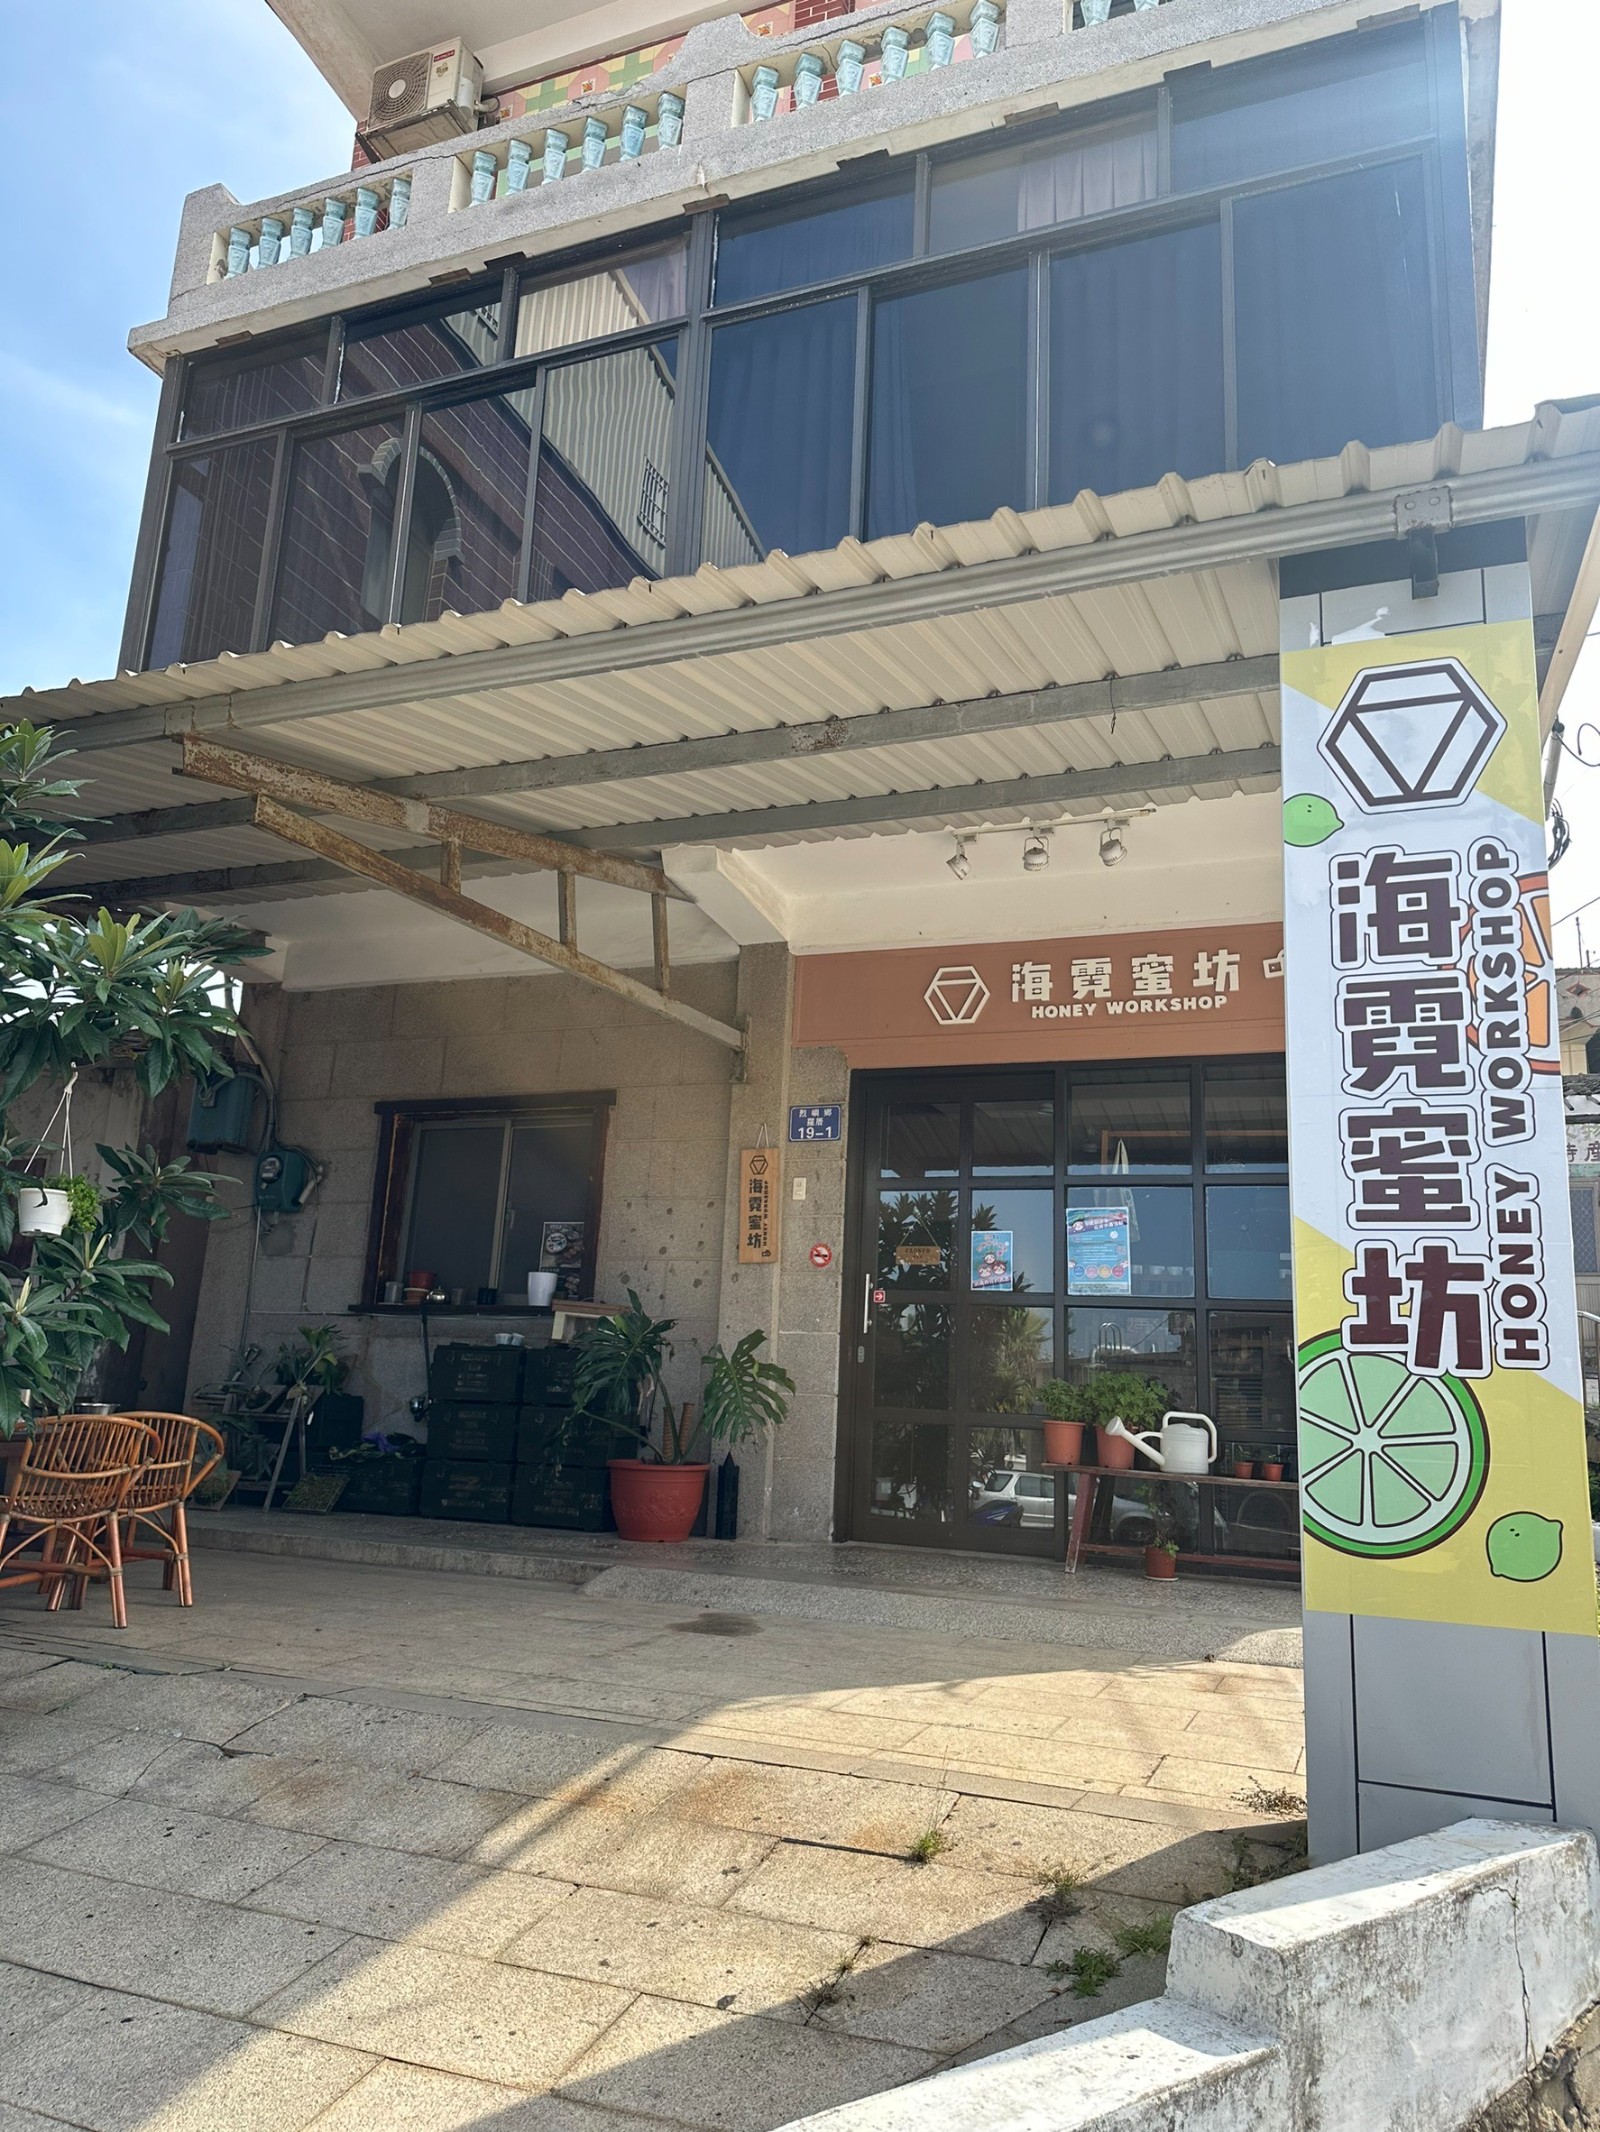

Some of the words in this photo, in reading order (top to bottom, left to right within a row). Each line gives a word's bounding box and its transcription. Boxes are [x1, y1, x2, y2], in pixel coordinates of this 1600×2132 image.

[1011, 949, 1240, 1002] 海霓蜜坊
[1031, 1003, 1097, 1019] HONEY
[1107, 995, 1228, 1015] WORKSHOP
[1476, 843, 1527, 1139] WORKSHOP
[798, 1126, 832, 1139] 19-1
[1337, 851, 1485, 1372] 海霓蜜坊
[747, 1178, 763, 1249] 海霓蜜坊
[1494, 1171, 1540, 1361] HONEY
